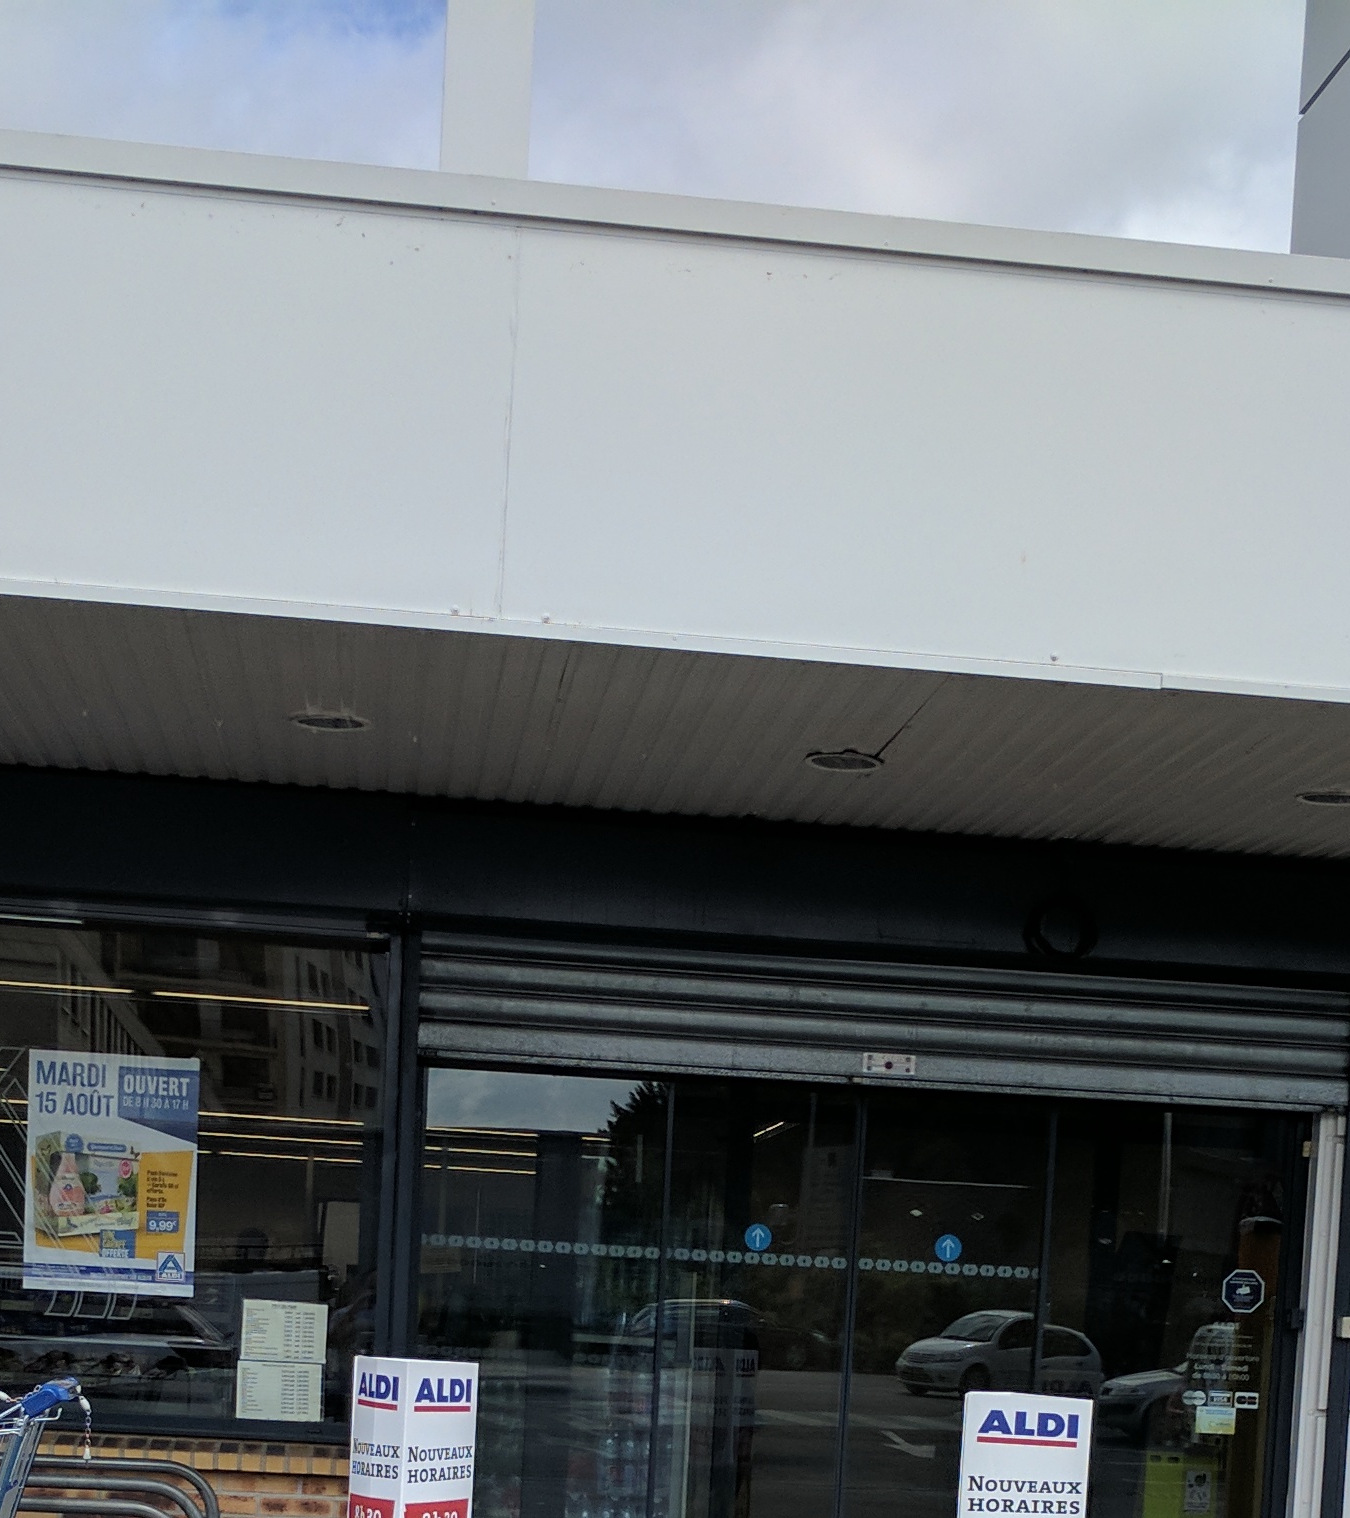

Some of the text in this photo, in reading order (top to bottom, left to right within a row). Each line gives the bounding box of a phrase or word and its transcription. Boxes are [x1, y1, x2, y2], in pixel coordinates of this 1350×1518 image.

[35, 1060, 107, 1088] MARDI
[124, 1074, 190, 1097] OUVERT
[35, 1090, 114, 1117] 15 AOÛT
[123, 1096, 133, 1107] DE
[182, 1100, 189, 1111] H
[358, 1371, 400, 1401] ALDI
[414, 1378, 472, 1403] ALDI
[978, 1409, 1080, 1439] ALDI
[352, 1460, 399, 1480] HORAIRES
[407, 1465, 472, 1484] HORAIRES
[967, 1498, 1080, 1515] HORAIRES
